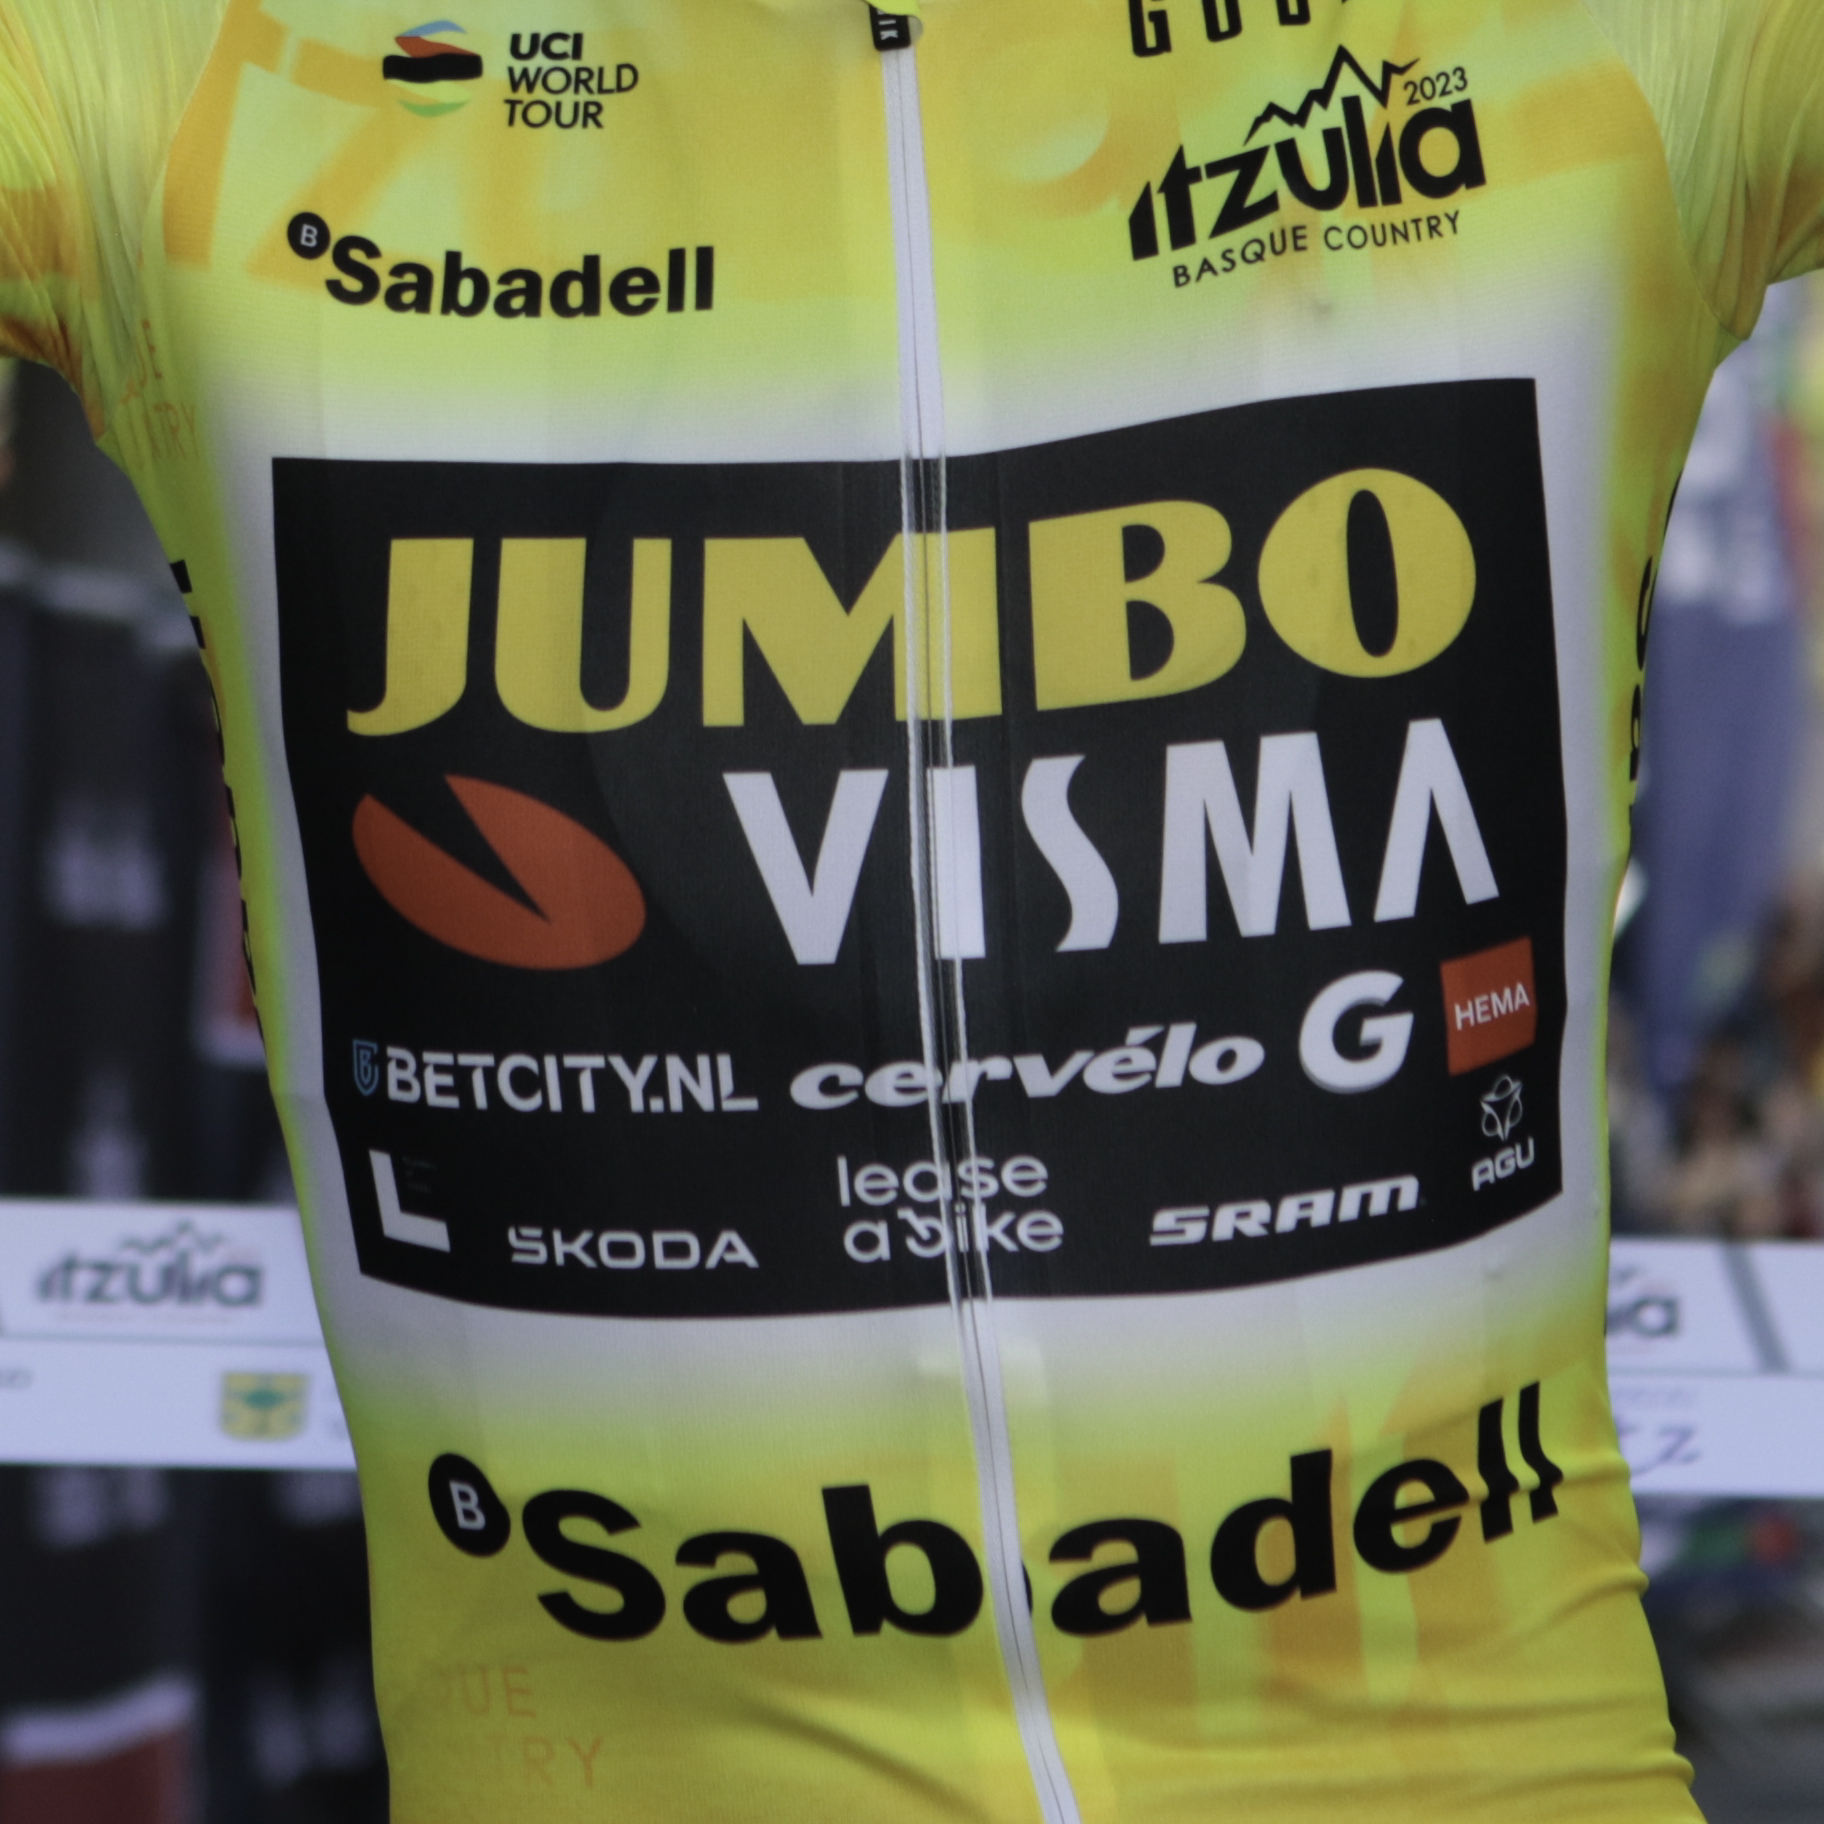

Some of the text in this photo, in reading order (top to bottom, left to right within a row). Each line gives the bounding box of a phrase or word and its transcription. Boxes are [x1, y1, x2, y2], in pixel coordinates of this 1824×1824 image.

[507, 63, 639, 95] WORLD
[509, 32, 584, 61] UCI
[504, 99, 604, 130] TOUR
[1404, 67, 1469, 107] 2023
[325, 235, 715, 319] Sabadell
[1173, 210, 1462, 288] BASQUE COUNTRY
[347, 468, 1476, 737] JUMBO
[722, 717, 1500, 965] VISMA
[1298, 971, 1415, 1094] G
[1454, 982, 1530, 1031] HEMA
[386, 1046, 759, 1112] BETCITY.NL
[790, 1023, 1266, 1110] cervélo
[836, 1155, 1049, 1207] lease
[1471, 1137, 1535, 1191] AGU
[1149, 1176, 1420, 1246] SRAM
[521, 1381, 1565, 1644] Sabadell
